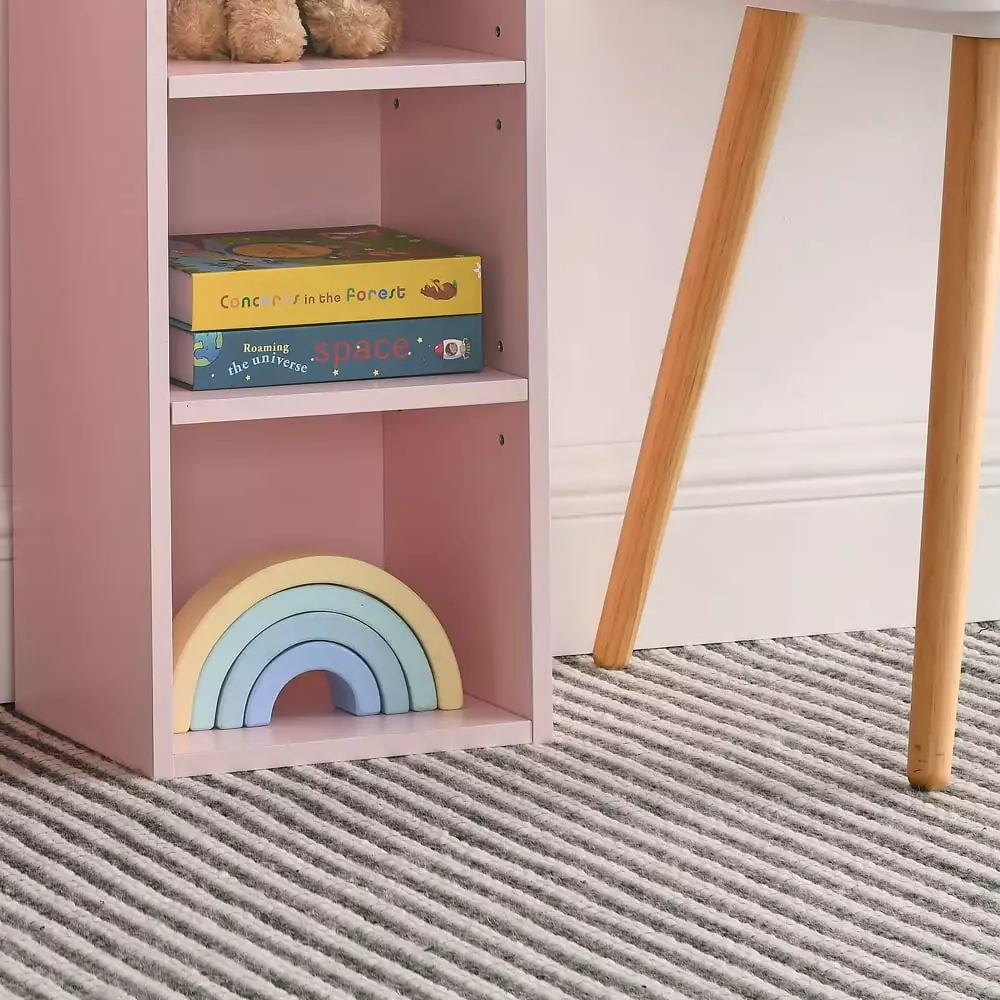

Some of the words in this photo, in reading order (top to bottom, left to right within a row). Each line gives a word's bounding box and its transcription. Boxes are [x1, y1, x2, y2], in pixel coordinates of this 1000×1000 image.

[220, 294, 300, 309] Concrs
[304, 294, 315, 304] in
[319, 292, 341, 304] the
[243, 342, 290, 353] Roaming
[314, 336, 410, 369] space
[228, 360, 250, 376] the
[252, 352, 308, 374] universe
